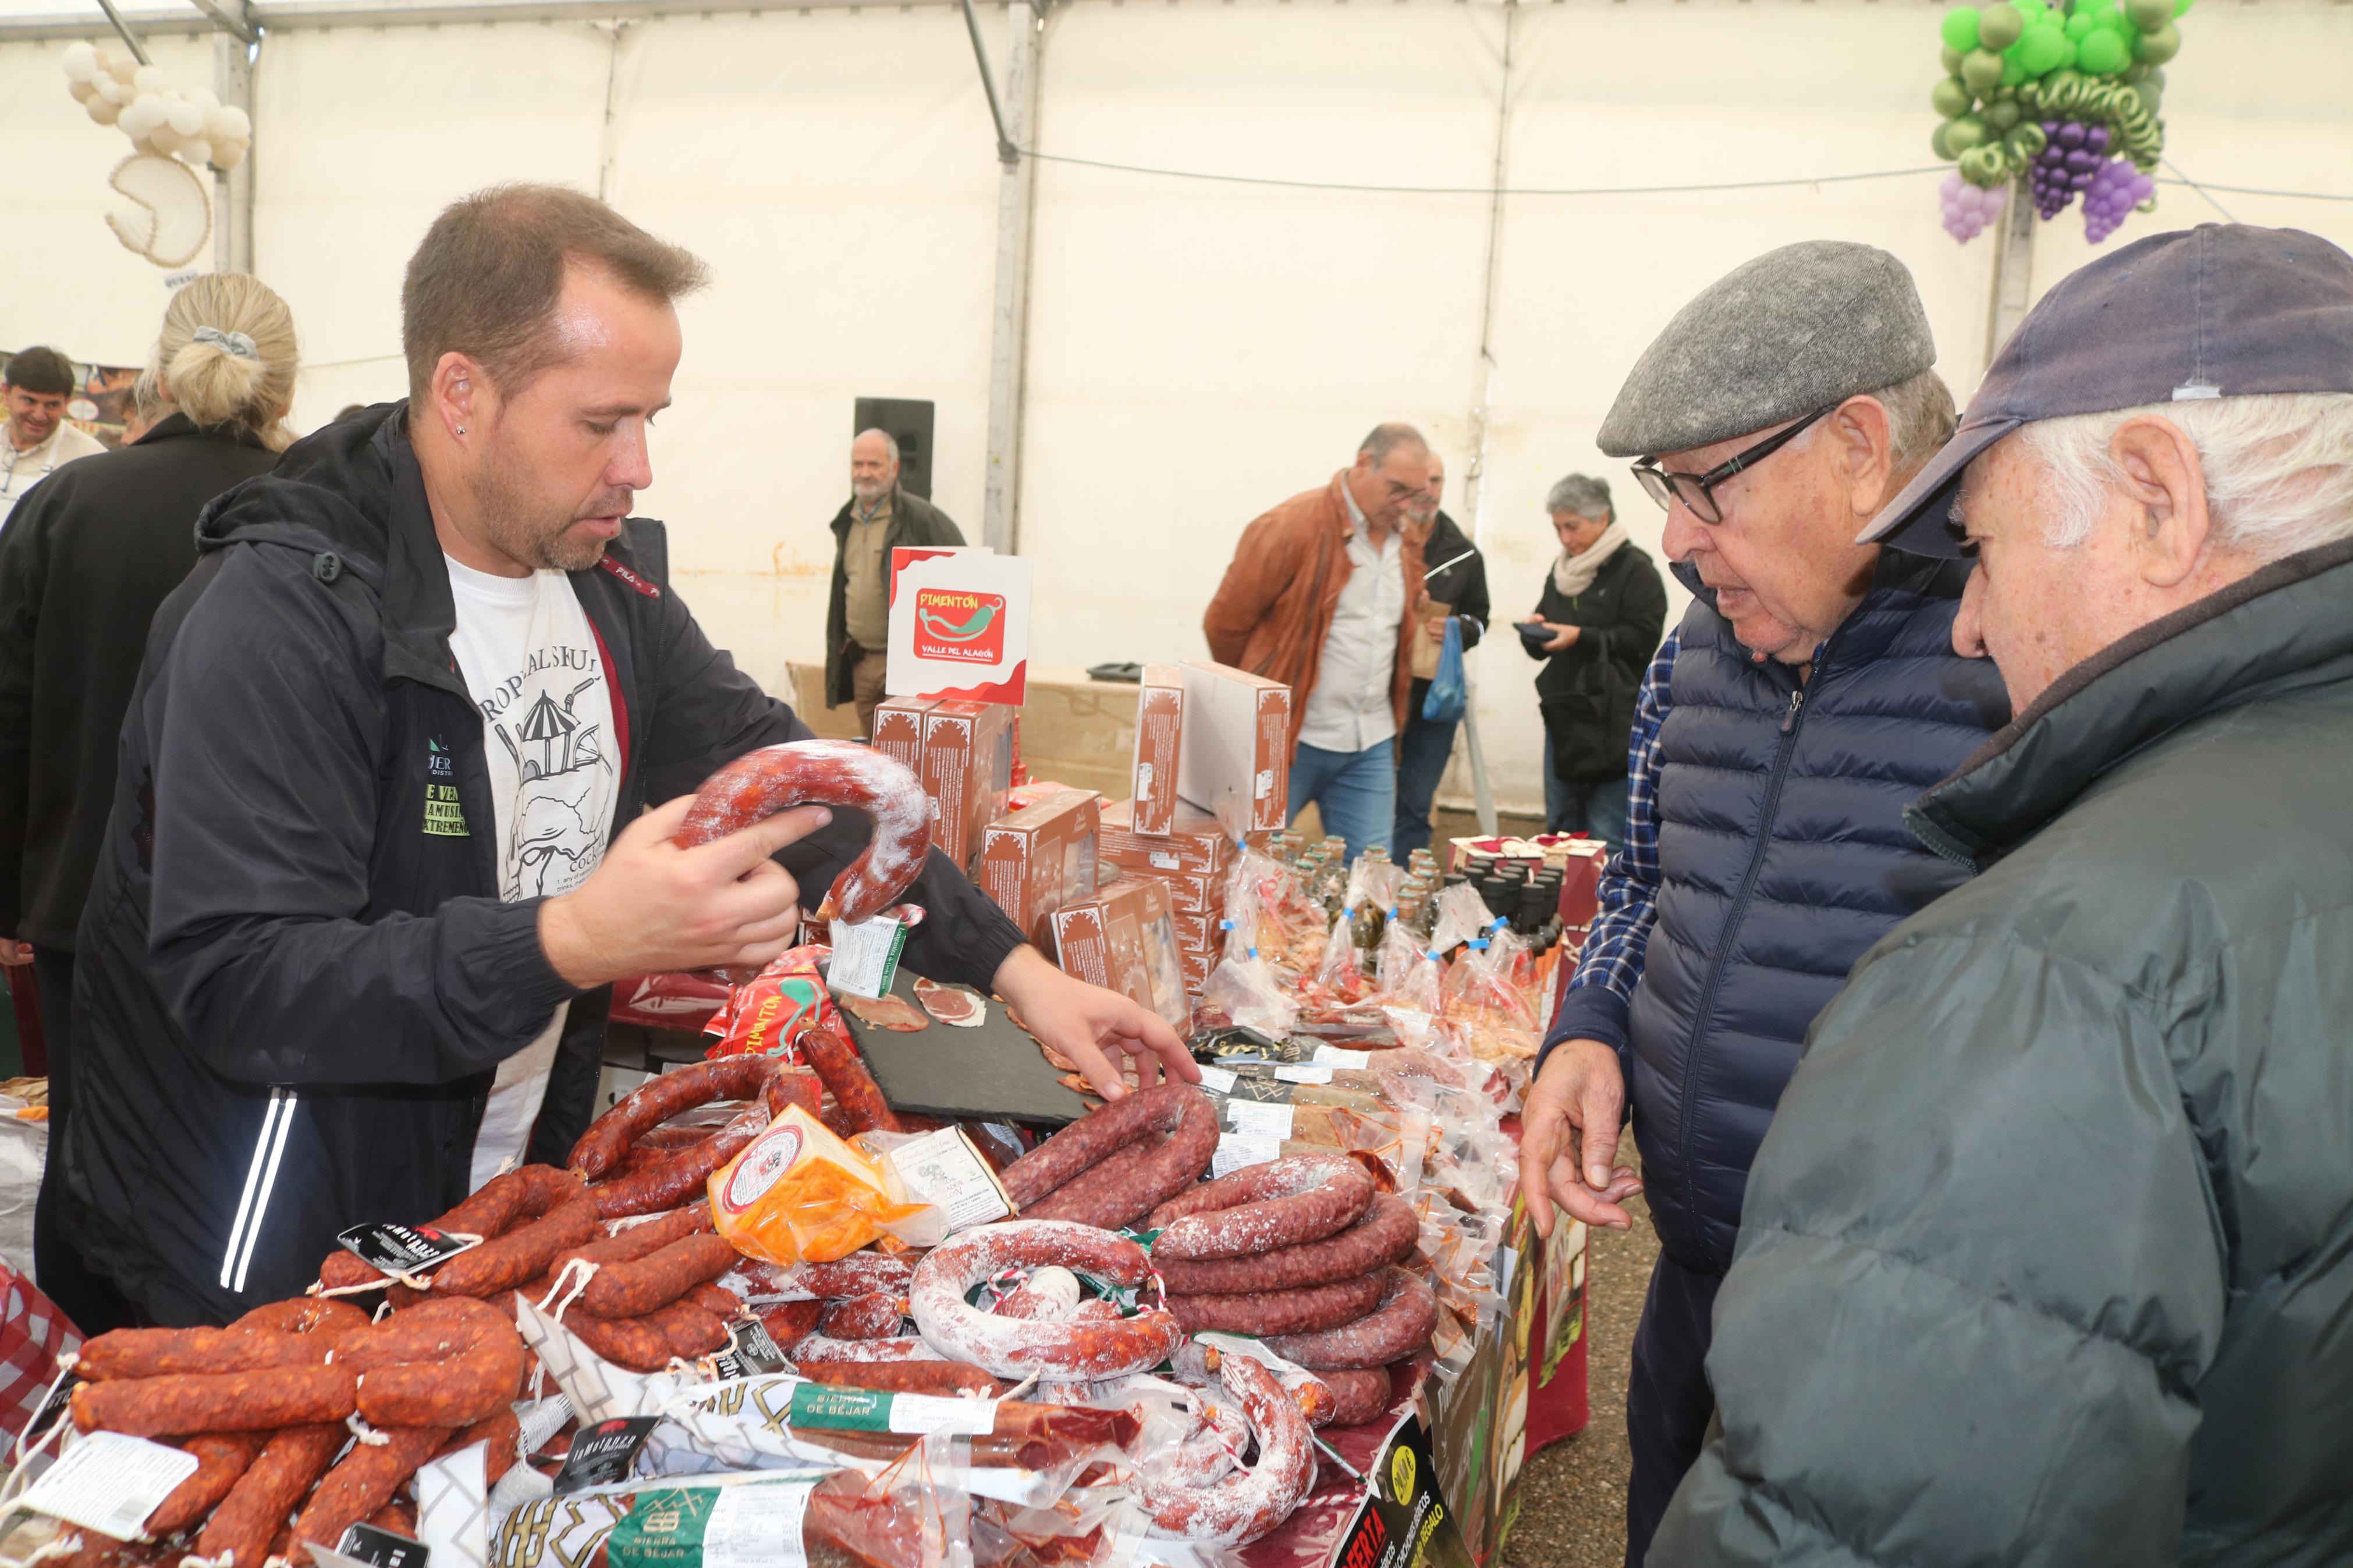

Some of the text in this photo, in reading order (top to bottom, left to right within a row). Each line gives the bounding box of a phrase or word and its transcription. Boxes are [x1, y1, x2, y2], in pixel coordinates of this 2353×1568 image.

[616, 567, 636, 582] FILA
[920, 593, 978, 609] PIMENTÓN
[922, 645, 993, 659] VALLE DEL ALAGÓN
[892, 927, 905, 957] Longaniza
[807, 1403, 871, 1416] DE BÉJAR
[1419, 1503, 1444, 1548] REGALO
